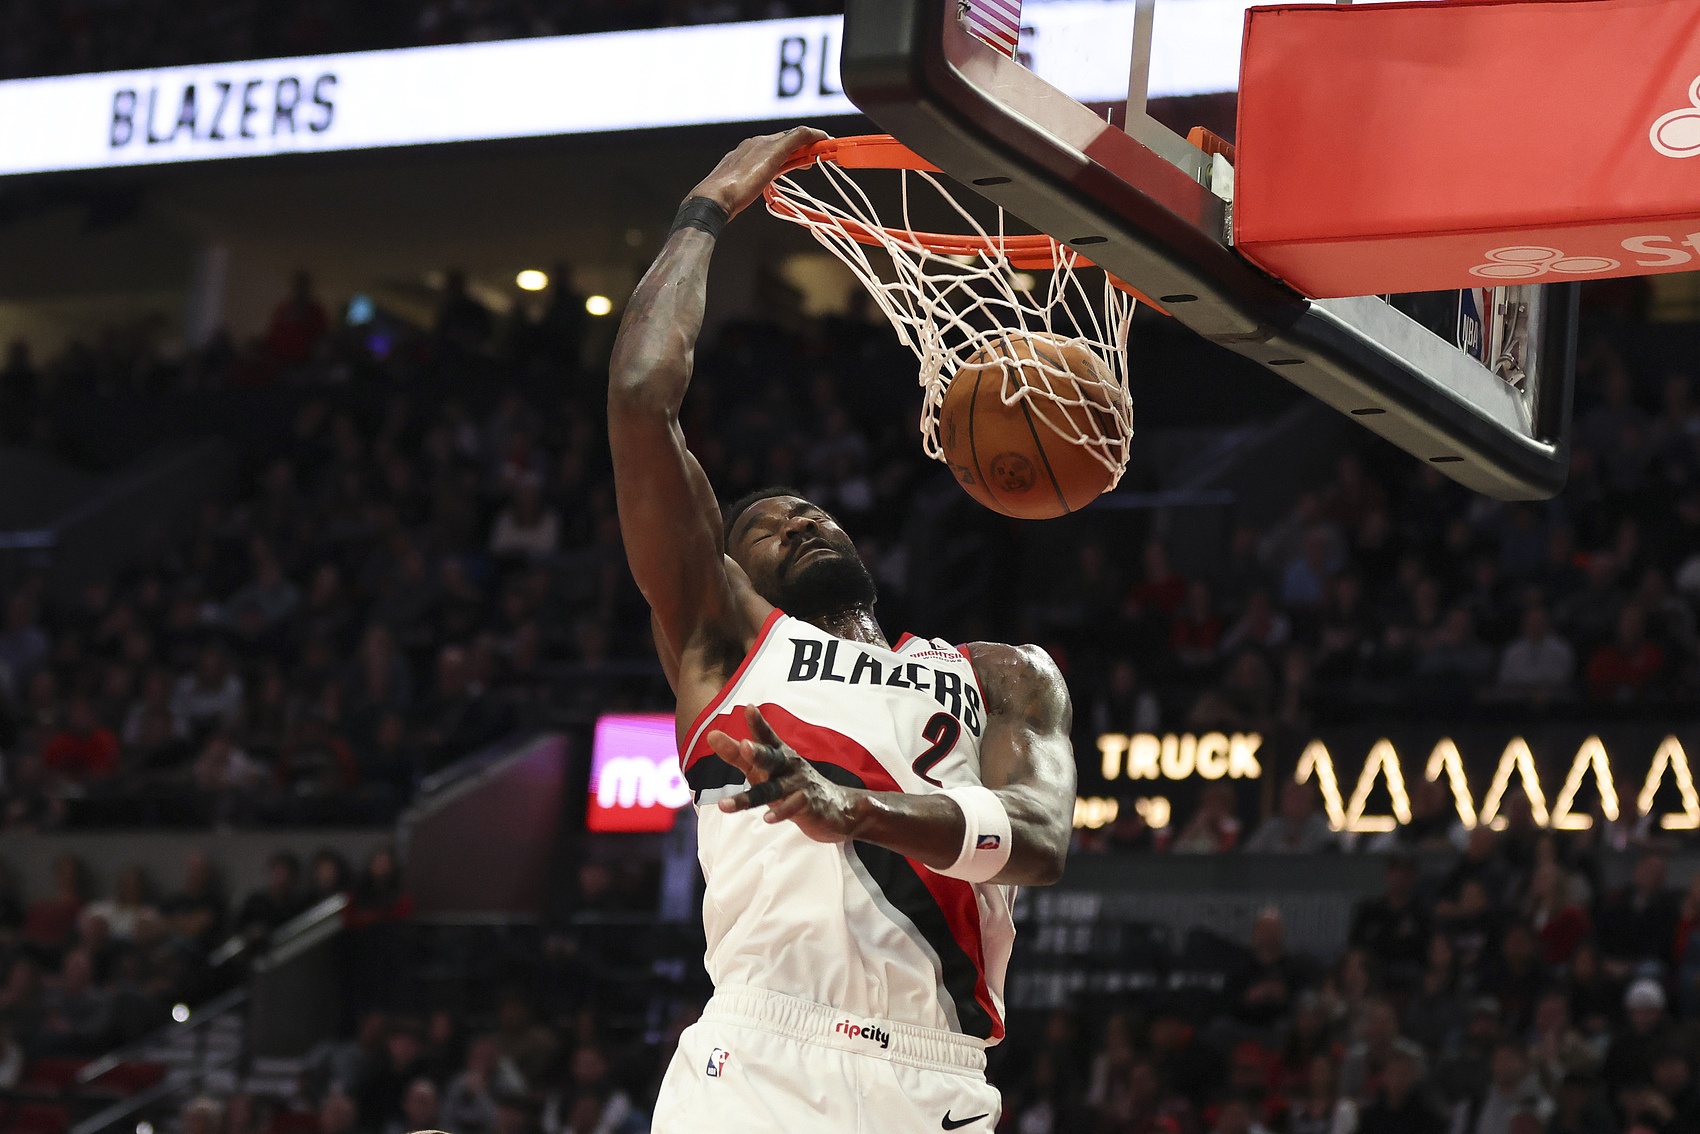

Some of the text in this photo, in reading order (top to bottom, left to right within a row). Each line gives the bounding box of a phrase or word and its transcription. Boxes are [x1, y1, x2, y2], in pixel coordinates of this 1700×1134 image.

[110, 73, 338, 148] BLAZERS
[1463, 313, 1479, 350] NBA
[787, 637, 981, 738] BLAZERS
[911, 711, 961, 789] 2
[1096, 731, 1263, 781] TRUCK
[835, 1019, 890, 1049] ripcity
